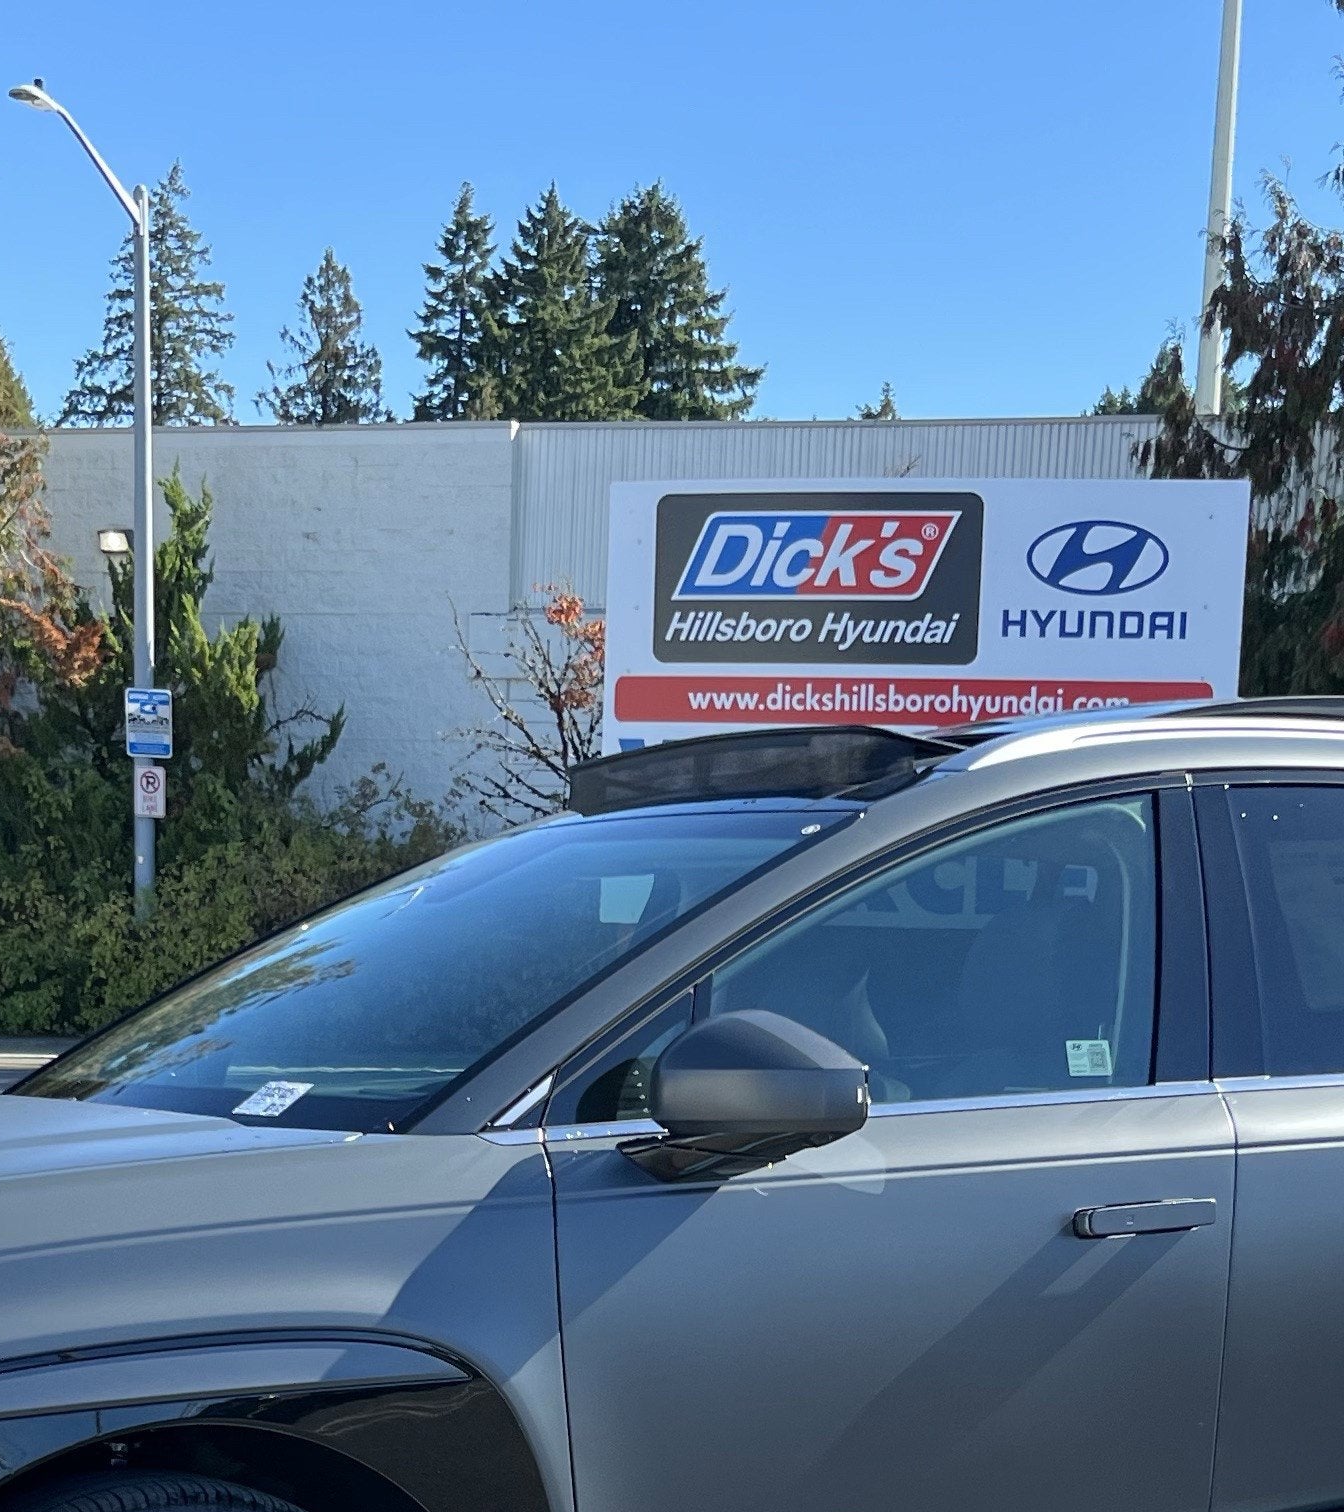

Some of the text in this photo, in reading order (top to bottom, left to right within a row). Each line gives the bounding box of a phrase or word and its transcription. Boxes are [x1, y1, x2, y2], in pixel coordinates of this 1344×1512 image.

[694, 520, 925, 591] Dick's
[665, 611, 961, 651] Hillsboro Hyundai
[1001, 608, 1188, 640] HYUNDAI
[687, 683, 1130, 721] www.dickshillsborohyundaicom
